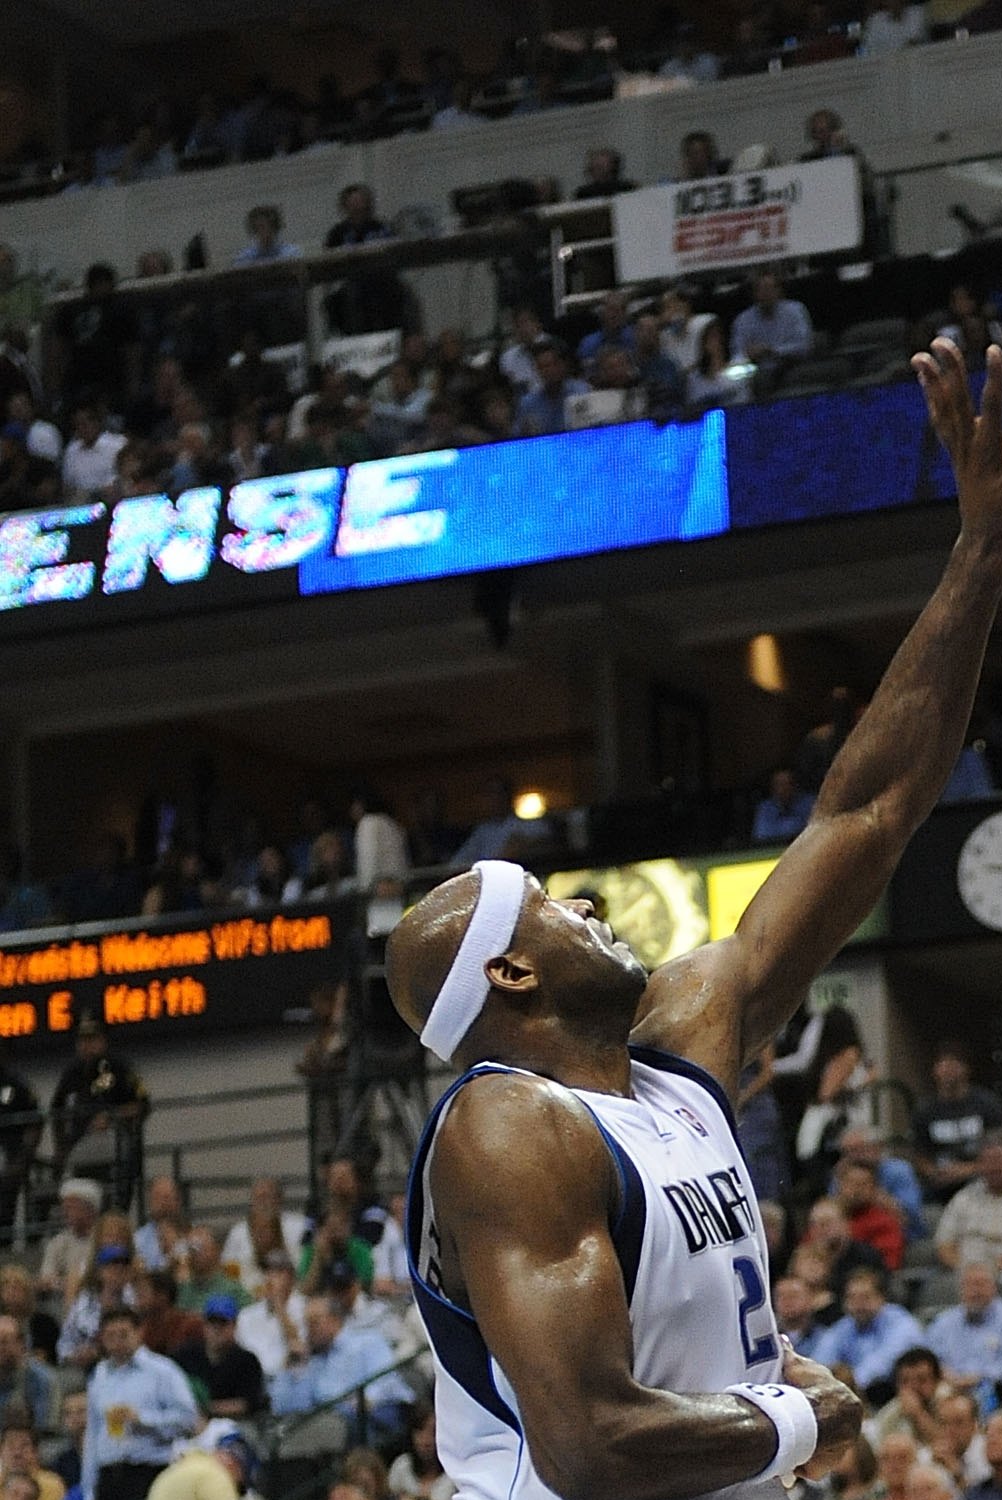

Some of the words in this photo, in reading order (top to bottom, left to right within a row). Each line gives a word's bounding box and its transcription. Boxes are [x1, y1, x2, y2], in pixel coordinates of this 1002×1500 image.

[674, 203, 787, 253] ESPN
[0, 448, 458, 611] ENSE
[49, 990, 72, 1031] E
[104, 976, 206, 1024] Keith
